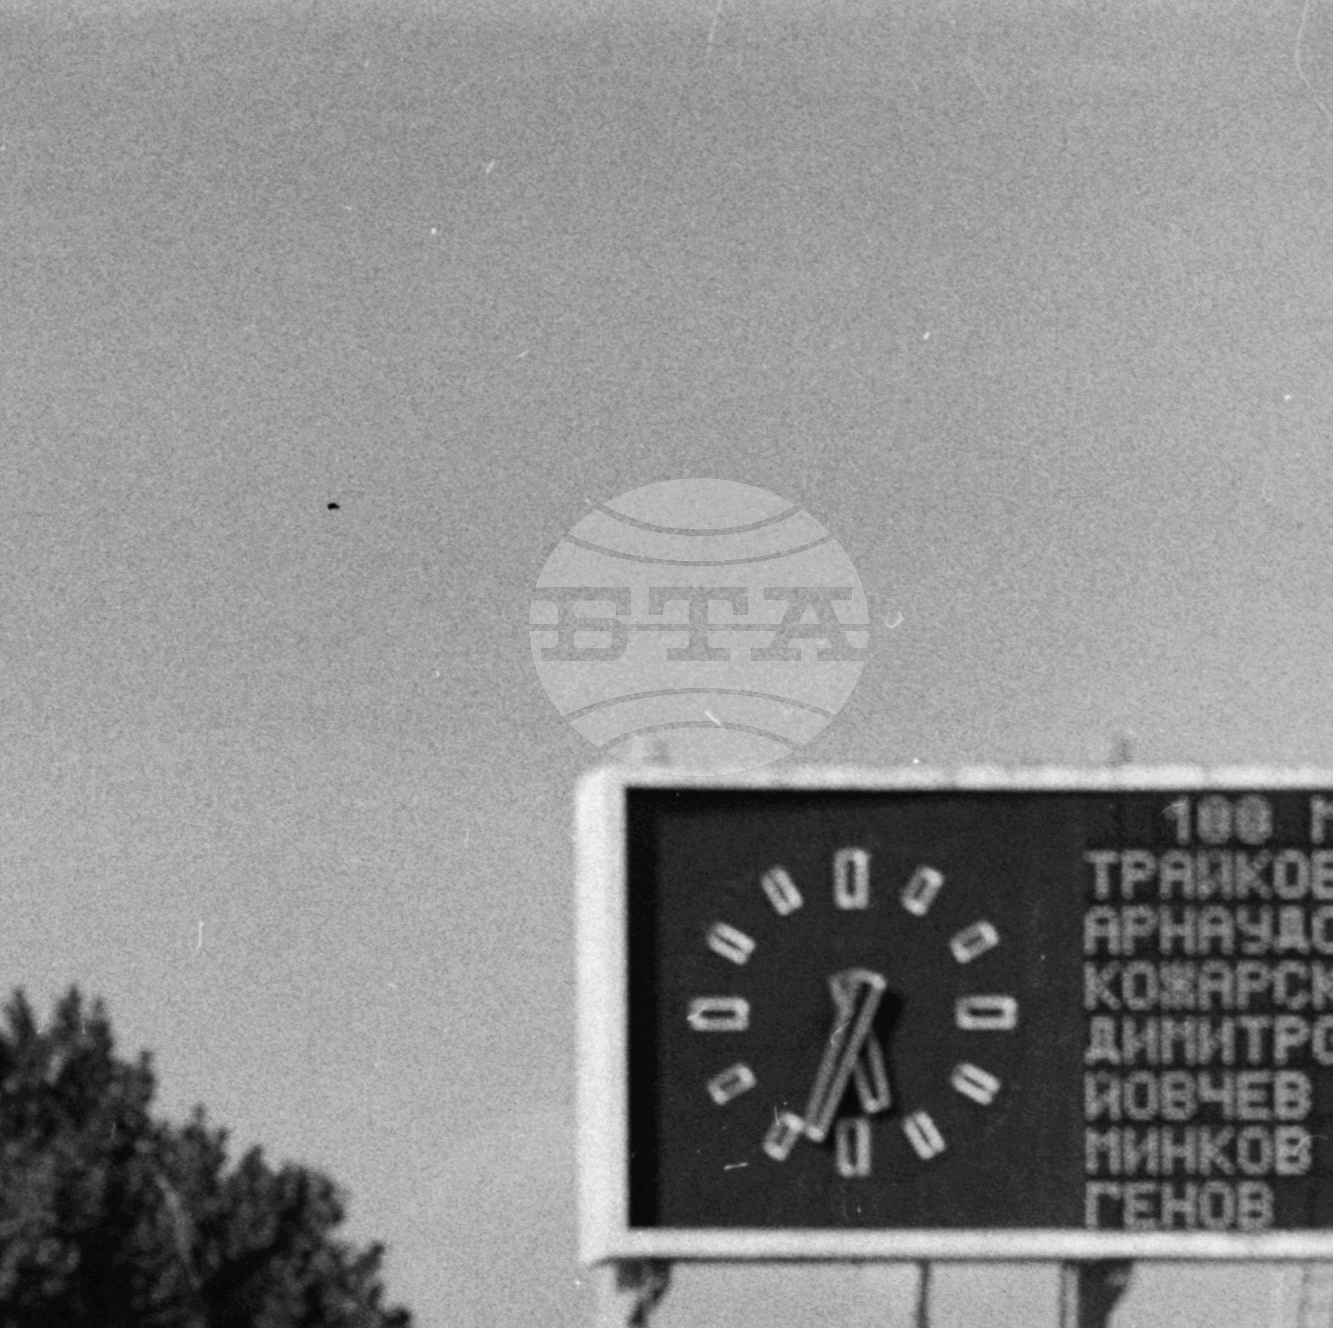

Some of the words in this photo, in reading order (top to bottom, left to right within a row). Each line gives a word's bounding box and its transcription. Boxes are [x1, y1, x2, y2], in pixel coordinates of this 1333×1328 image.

[1165, 795, 1273, 845] 100
[1084, 1126, 1311, 1175] МИНКОВ
[1084, 1181, 1274, 1231] ГЕНОВ
